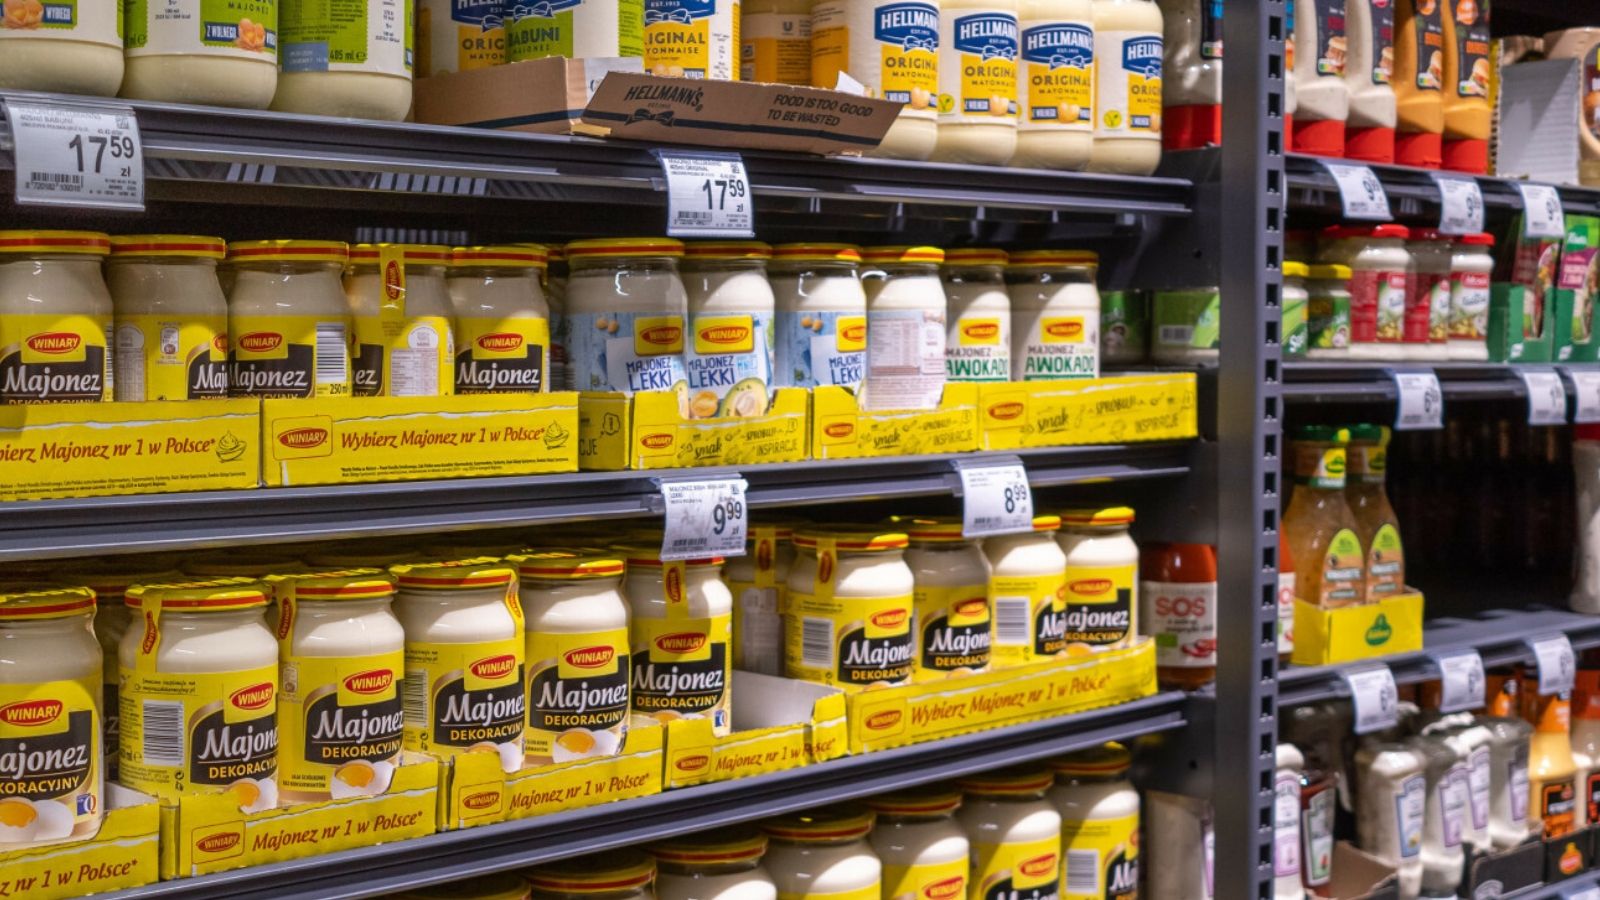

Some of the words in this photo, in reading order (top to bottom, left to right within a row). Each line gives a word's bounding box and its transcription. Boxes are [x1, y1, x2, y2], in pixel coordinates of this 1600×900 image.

[645, 31, 706, 45] IGINAL
[773, 94, 803, 106] FOOD
[804, 96, 814, 107] IS
[815, 97, 838, 110] TOO
[840, 102, 874, 117] GOOD
[767, 109, 781, 120] TO
[782, 111, 798, 122] BE
[798, 112, 841, 127] WASTED
[242, 335, 282, 346] WINIARY
[483, 338, 521, 346] WINIARY
[708, 329, 747, 338] WINIARY
[34, 338, 77, 349] WINIARY
[1028, 346, 1074, 354] MAJONEZ
[627, 357, 671, 373] MAJONEZ
[1025, 356, 1095, 372] AWOKADO
[3, 366, 101, 398] Majonez
[456, 362, 540, 389] Majonez
[629, 371, 672, 391] LEKKI
[689, 368, 735, 389] LEKKI
[1037, 407, 1070, 433] smak
[287, 433, 326, 443] WINIARY
[341, 432, 398, 450] Wybierz
[401, 430, 458, 447] Majonez
[460, 431, 475, 443] nr
[479, 429, 485, 443] 1
[489, 430, 501, 441] w
[695, 438, 722, 456] smak
[874, 430, 901, 447] smak
[40, 442, 110, 464] Majonez
[113, 442, 131, 455] nr
[136, 439, 143, 455] 1
[149, 441, 162, 454] w
[756, 441, 798, 456] INSPIRACJE
[1155, 597, 1206, 617] SOS
[1066, 606, 1129, 632] ajonez
[660, 636, 704, 649] WINIARY
[571, 648, 613, 664] WINIARY
[477, 660, 514, 675] WINIARY
[351, 673, 392, 690] WINIARY
[632, 664, 723, 696] Majonez
[536, 681, 627, 713] Majonez
[637, 695, 718, 707] DEKORACYJNY
[911, 706, 965, 727] Wybierz
[970, 692, 1024, 713] Majonez
[1028, 689, 1043, 702] nr
[1047, 683, 1054, 699] 1
[1057, 687, 1066, 698] w
[6, 704, 60, 722] WINIARY
[545, 710, 624, 726] DEKORACYJNY
[312, 709, 404, 744] Majonez
[0, 743, 89, 779] ajonez
[715, 749, 762, 772] Majonez
[765, 750, 779, 762] nr
[781, 747, 787, 760] 1
[790, 748, 800, 759] w
[509, 789, 563, 811] Majonez
[565, 785, 581, 799] nr
[585, 780, 591, 796] 1
[594, 783, 606, 793] w
[252, 828, 319, 852] Majonez
[322, 825, 340, 839] nr
[343, 819, 352, 836] 1
[357, 820, 371, 832] w
[14, 877, 36, 891] nr
[41, 871, 51, 888] 1
[58, 871, 73, 885] w
